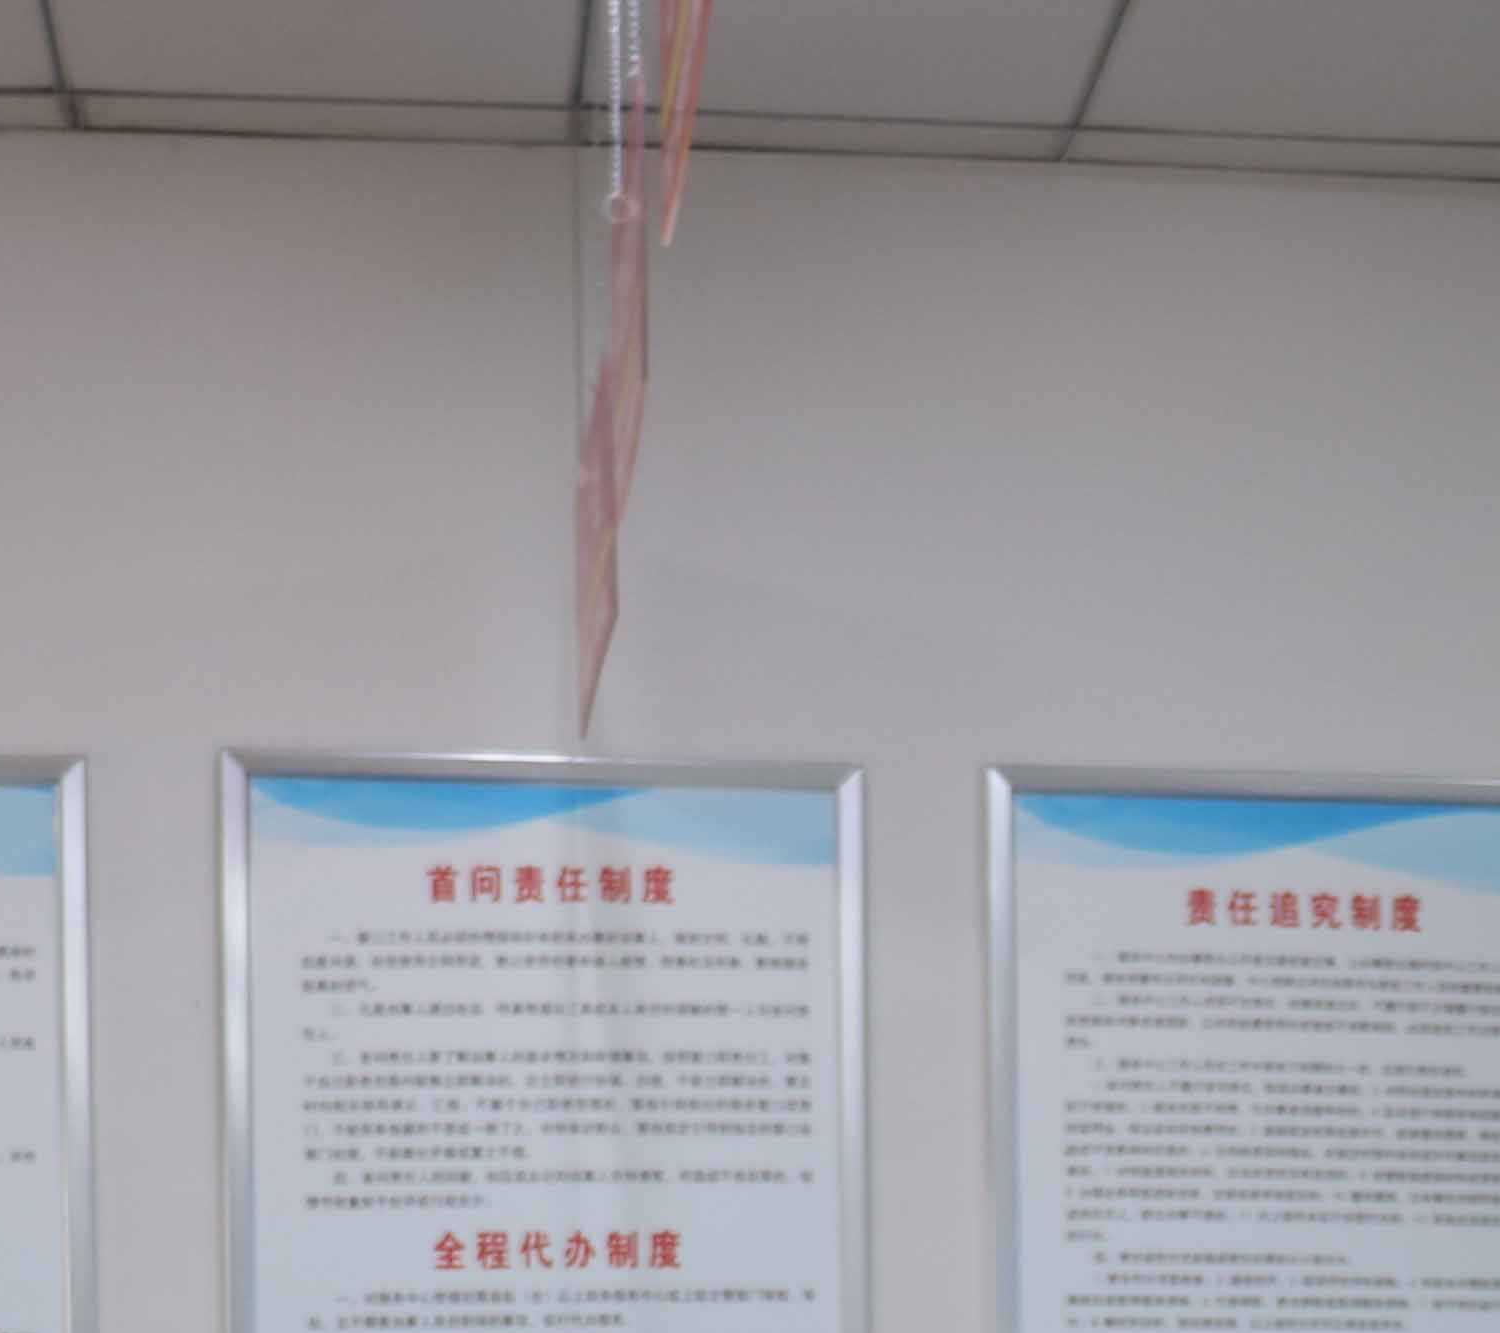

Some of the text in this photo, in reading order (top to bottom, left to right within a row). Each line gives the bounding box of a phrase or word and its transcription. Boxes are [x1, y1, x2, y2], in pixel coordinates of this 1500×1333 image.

[427, 863, 673, 904] 首问责任制度
[1187, 886, 1421, 932] 责任追究制度
[434, 1230, 680, 1271] 全程代办制度
